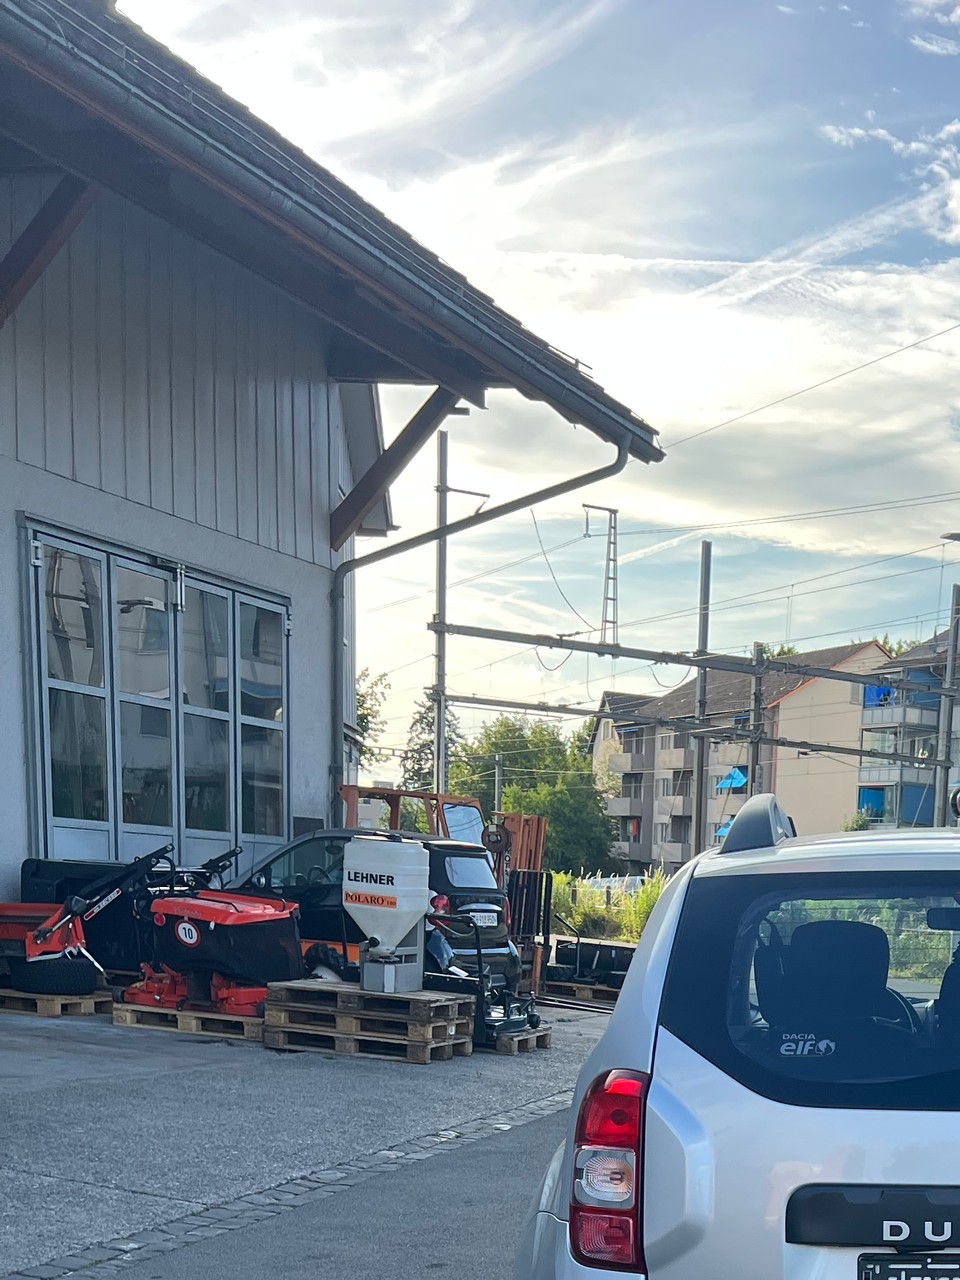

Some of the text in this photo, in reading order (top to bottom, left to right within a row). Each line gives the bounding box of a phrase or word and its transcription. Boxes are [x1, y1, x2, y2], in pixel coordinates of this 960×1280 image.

[347, 871, 395, 886] LEHNER
[345, 892, 384, 905] POLARO
[182, 926, 194, 940] 10
[780, 1040, 815, 1055] elf
